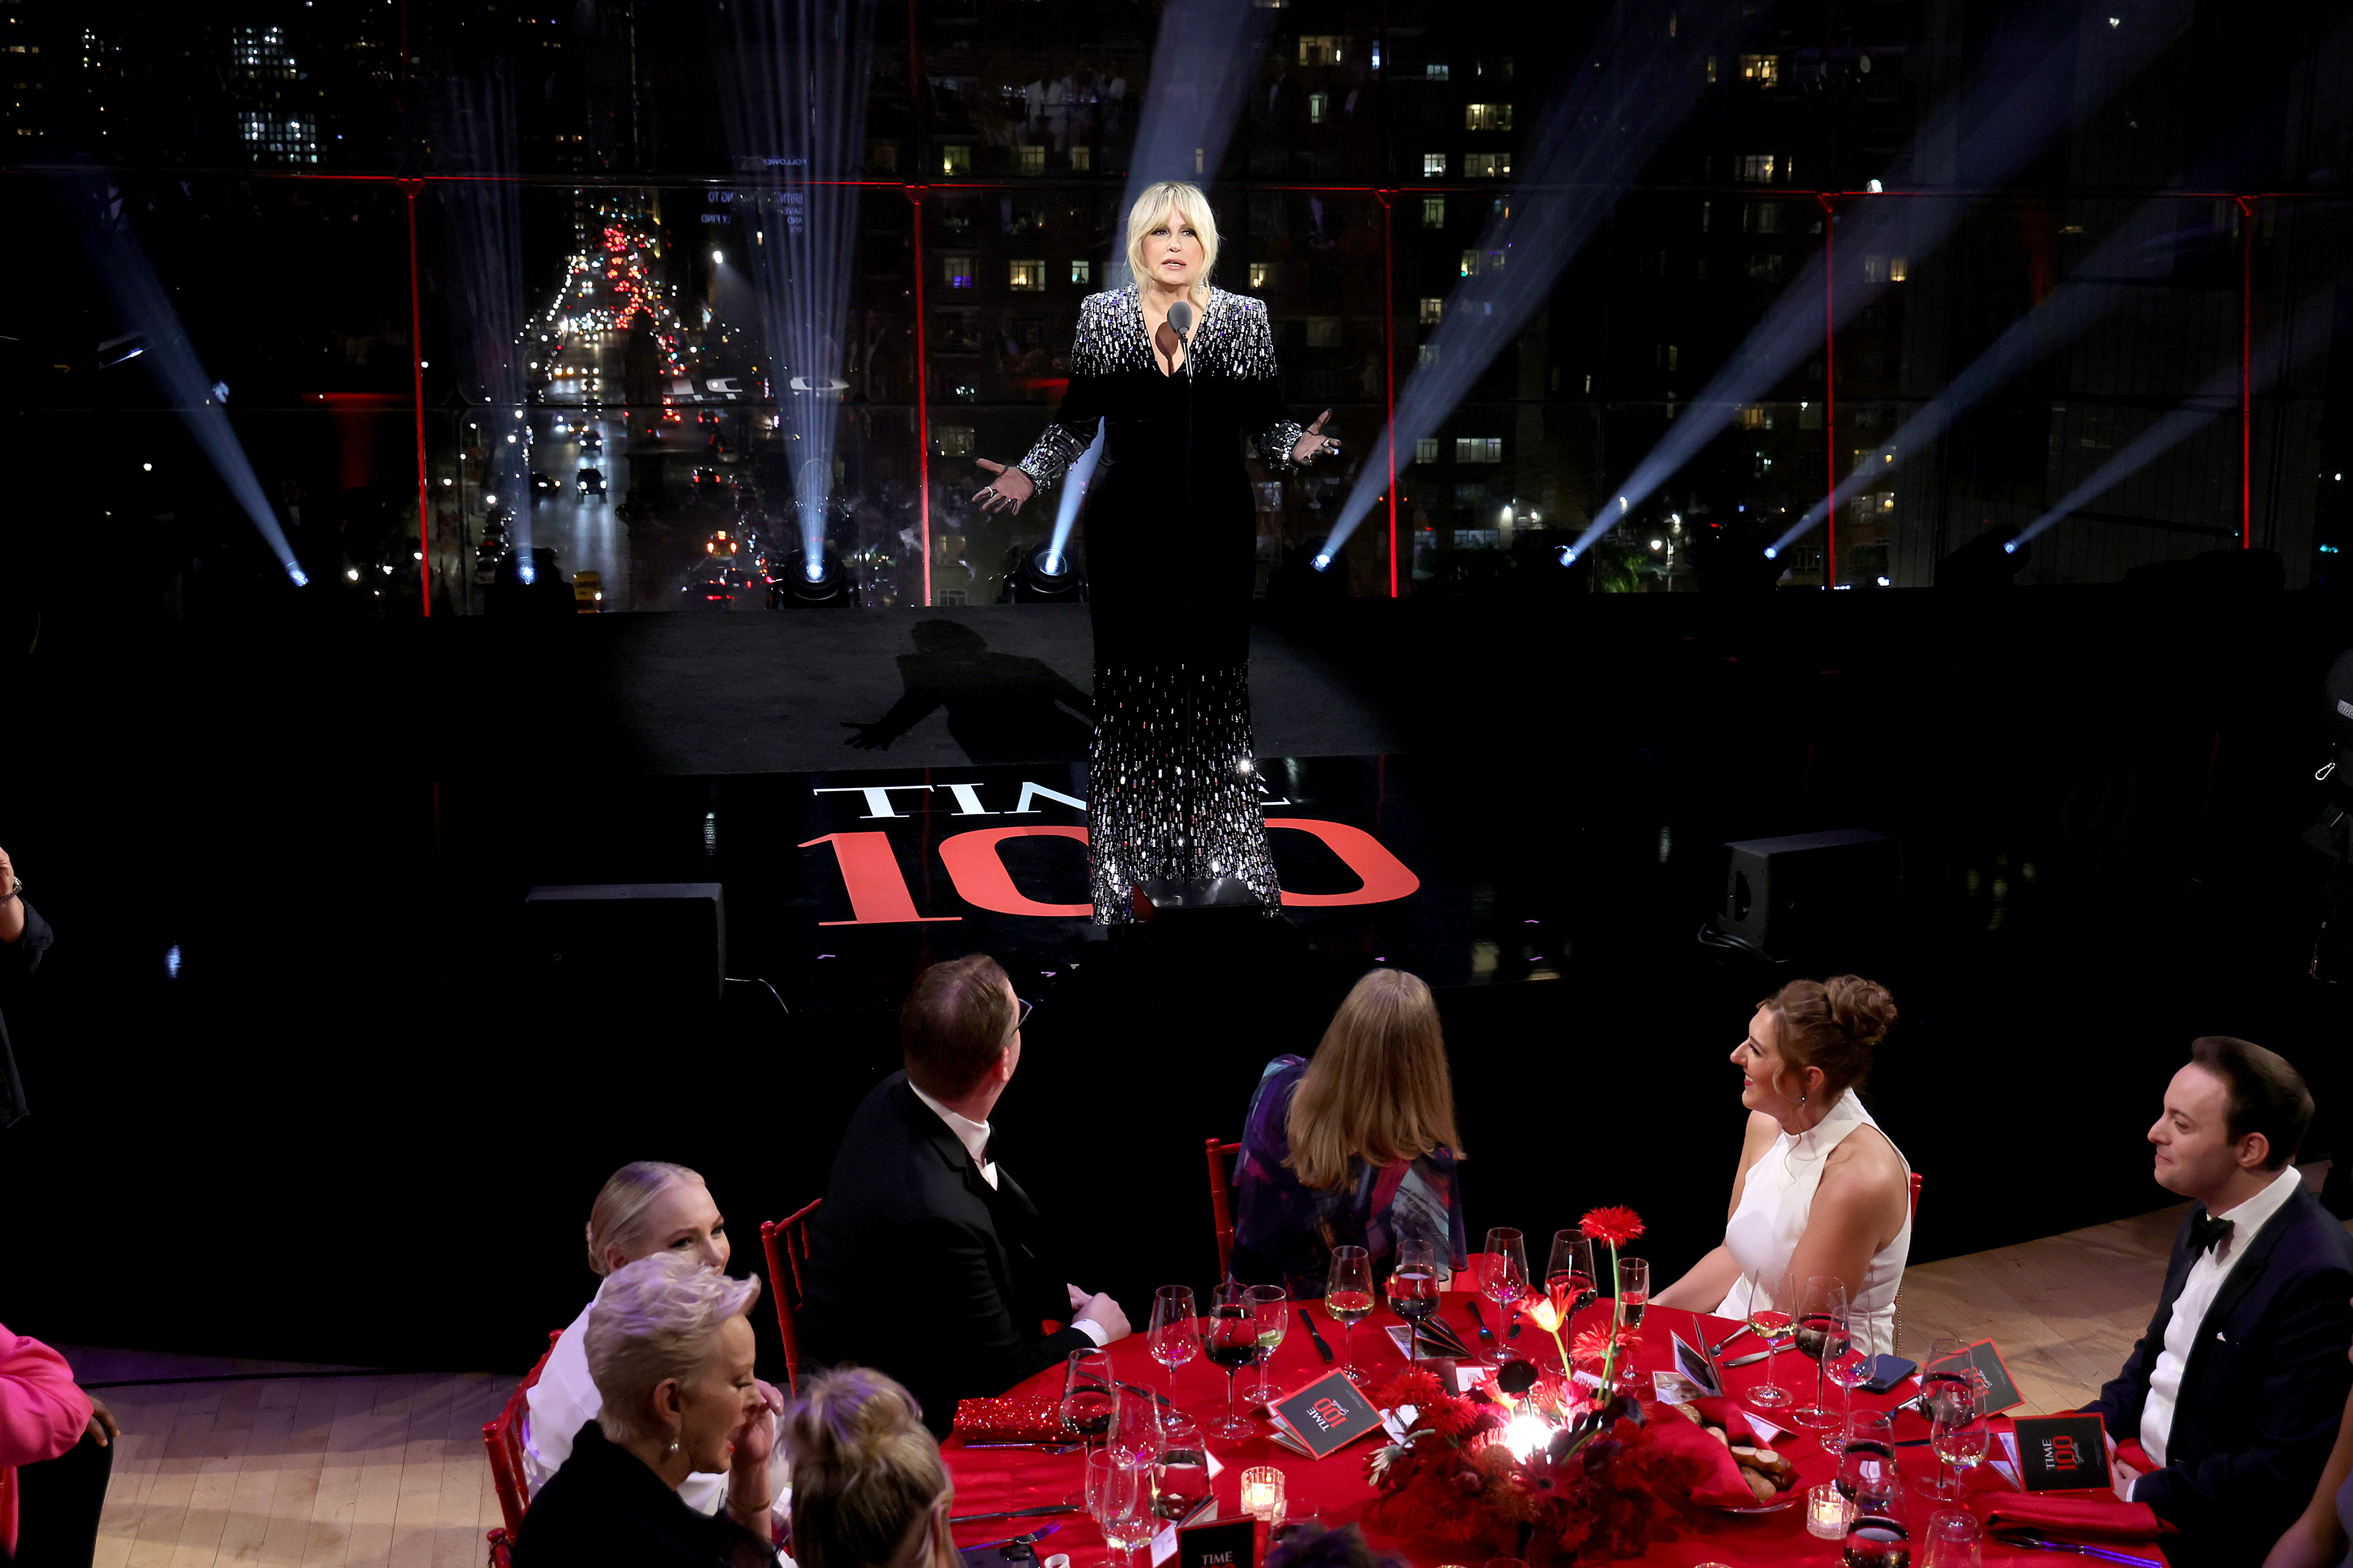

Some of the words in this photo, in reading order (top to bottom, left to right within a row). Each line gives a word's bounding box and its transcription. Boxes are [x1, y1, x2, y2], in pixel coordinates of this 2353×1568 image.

[1307, 1406, 1330, 1432] TIME
[1314, 1397, 1348, 1429] 100
[2042, 1438, 2055, 1471] TIME
[2052, 1435, 2078, 1472] 100
[1201, 1550, 1234, 1566] TIME
